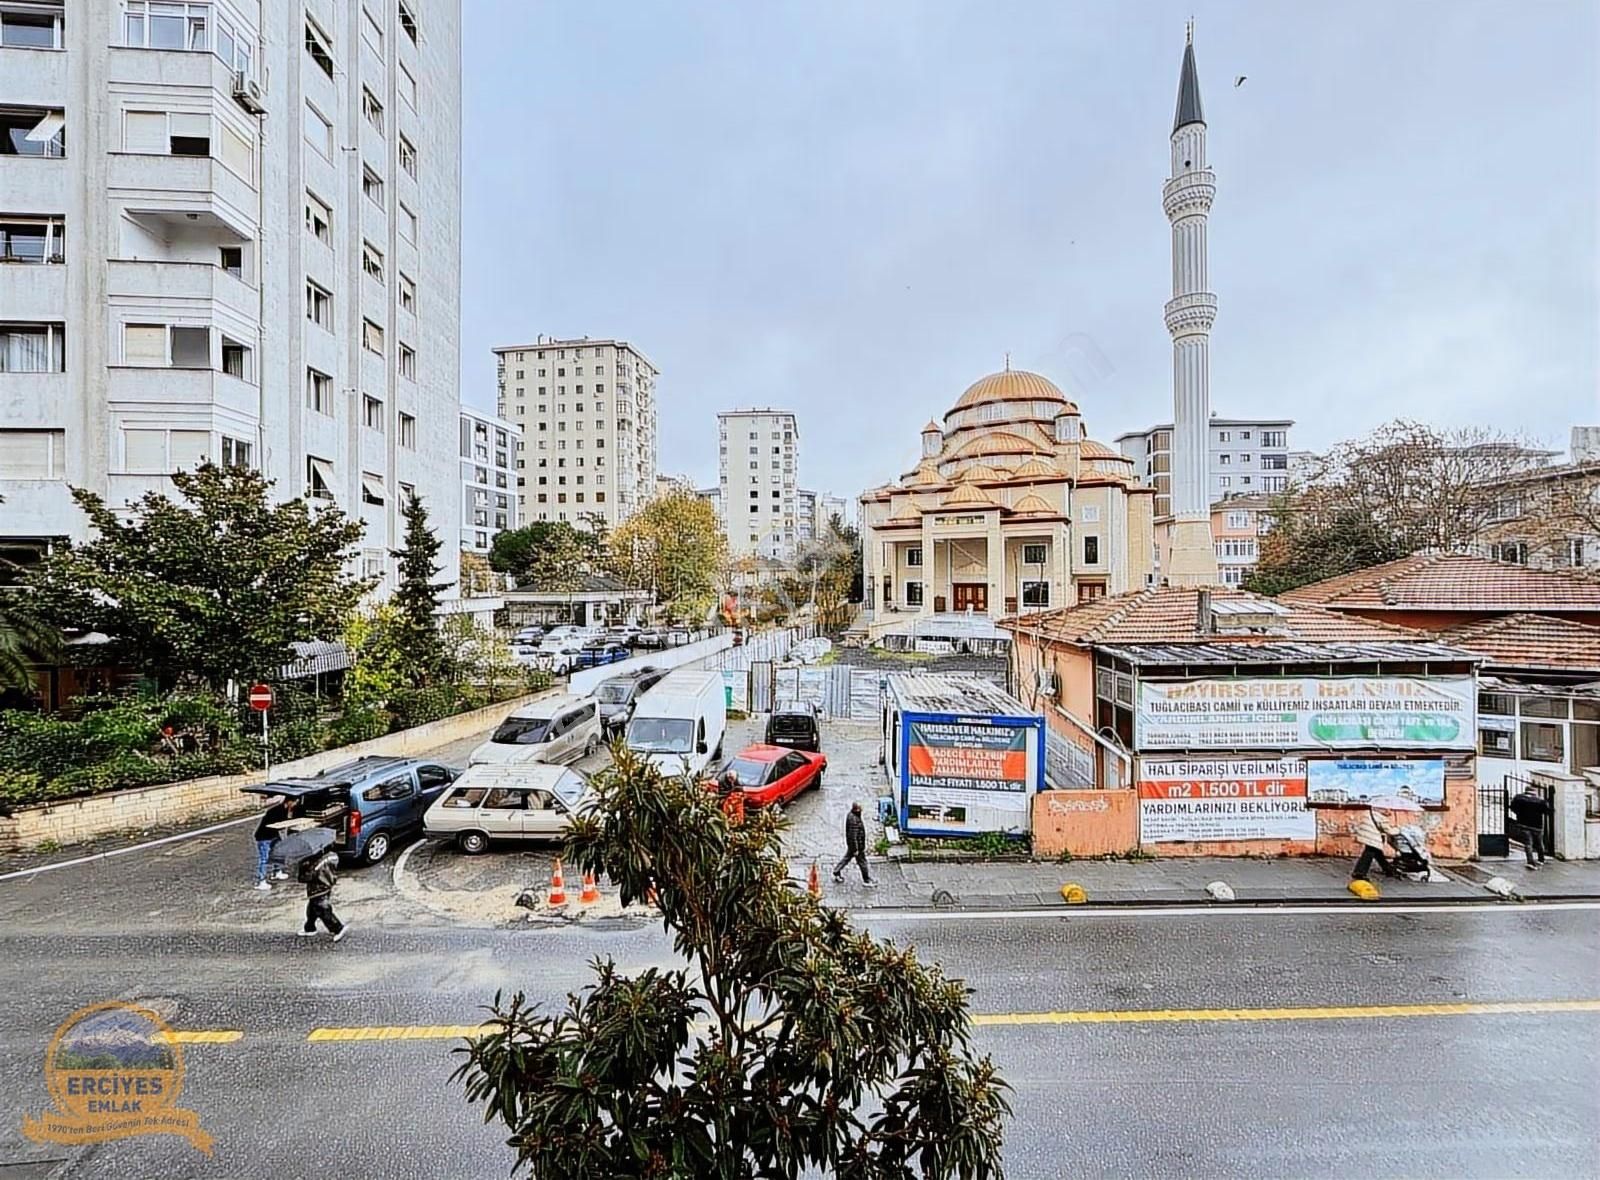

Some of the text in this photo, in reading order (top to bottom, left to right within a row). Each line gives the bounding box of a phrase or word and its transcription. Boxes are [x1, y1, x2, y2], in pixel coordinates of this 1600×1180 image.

[1243, 702, 1254, 712] ve
[1149, 764, 1175, 775] HALI
[1179, 760, 1229, 778] SİPARİŞİ
[999, 780, 1009, 790] TL
[1168, 783, 1192, 797] m2
[1243, 782, 1262, 796] TL
[1265, 781, 1286, 796] dir
[1143, 803, 1236, 814] YARDIMLARINIZI
